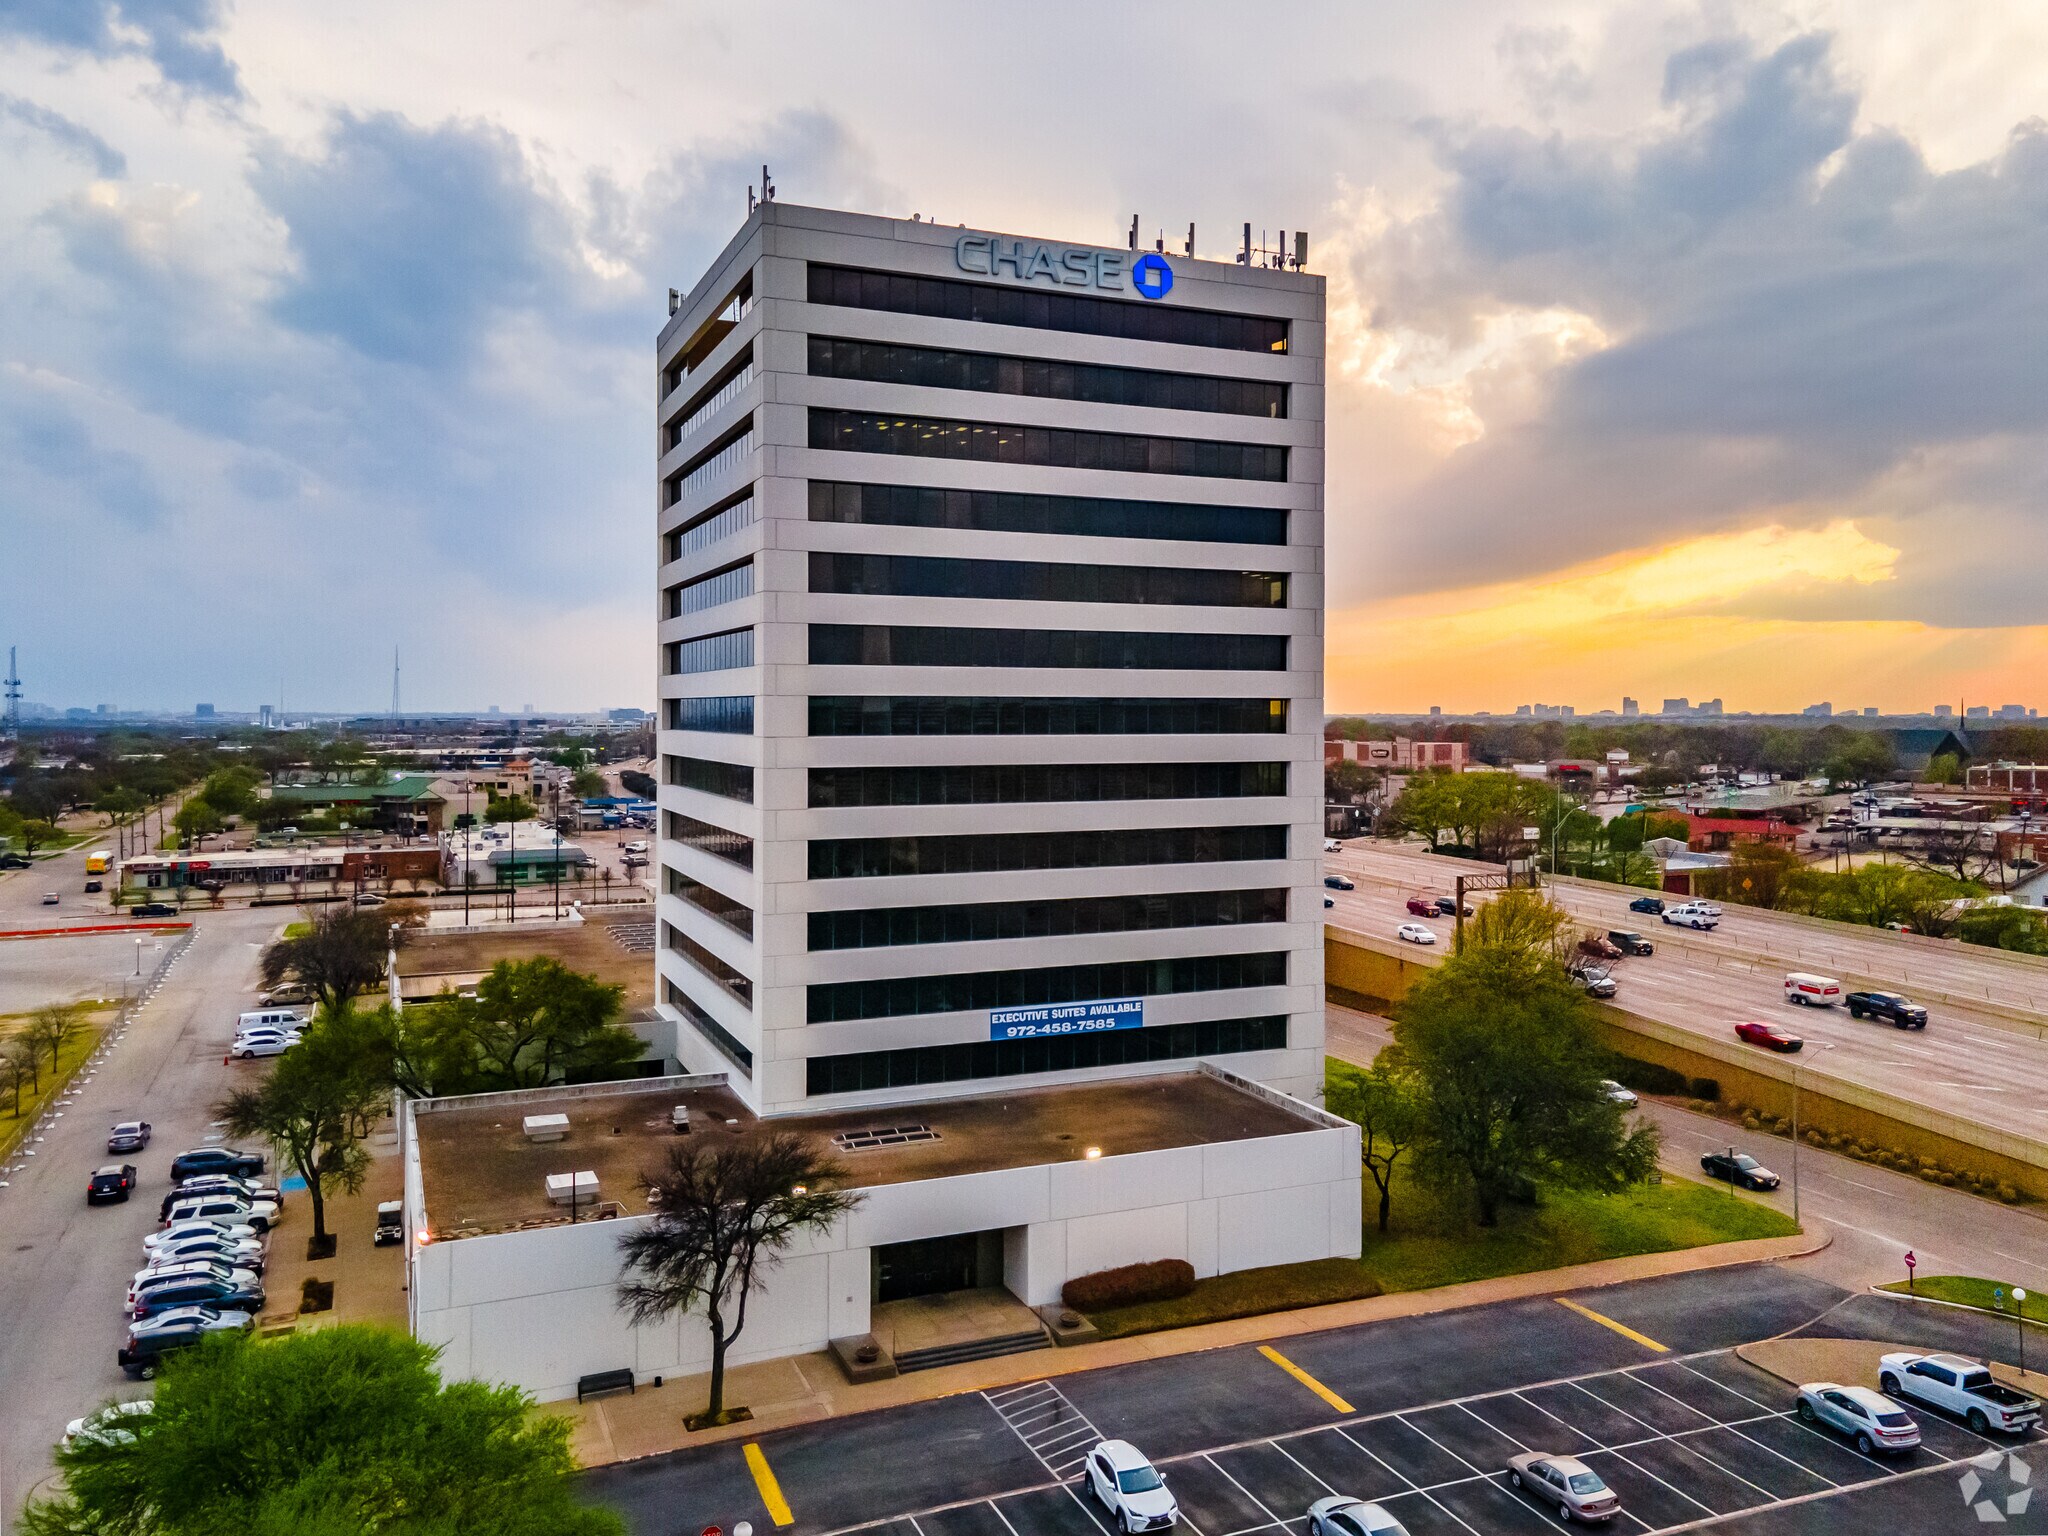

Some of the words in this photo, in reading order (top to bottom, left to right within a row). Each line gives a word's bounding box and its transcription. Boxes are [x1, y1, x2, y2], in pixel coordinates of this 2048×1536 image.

[956, 235, 1124, 291] CHASE
[992, 1010, 1049, 1024] EXECUTIVE
[1051, 1007, 1086, 1019] SUITES
[1089, 1002, 1142, 1015] AVAILABLE
[1007, 1018, 1116, 1037] 972-458-7585
